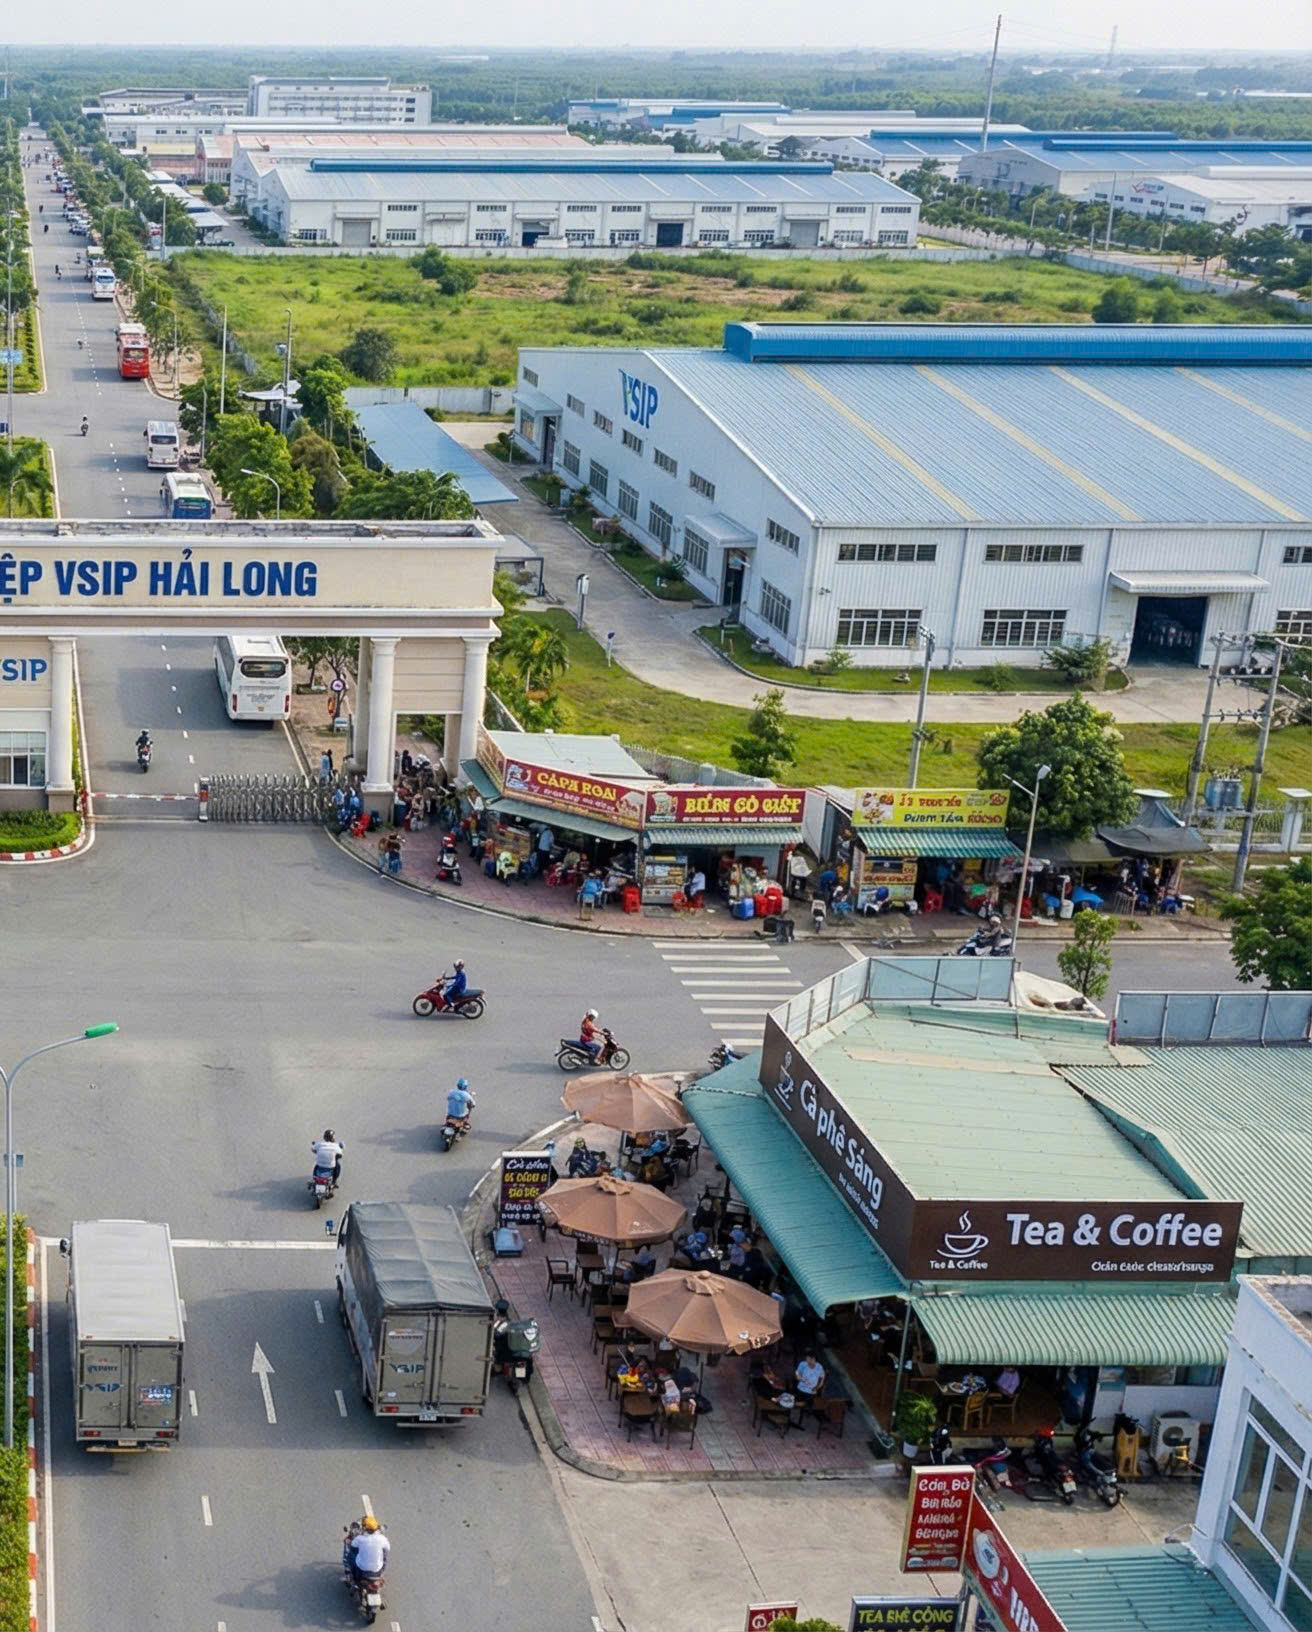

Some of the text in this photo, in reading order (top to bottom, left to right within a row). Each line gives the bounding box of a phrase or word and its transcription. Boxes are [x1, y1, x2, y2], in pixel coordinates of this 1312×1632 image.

[618, 368, 658, 429] VSIP
[55, 561, 137, 596] VSIP
[149, 549, 209, 596] HẢI
[224, 561, 317, 597] LONG
[817, 1108, 846, 1156] phê
[846, 1138, 883, 1209] Sáng
[1007, 1213, 1223, 1246] Tea & Coffee
[858, 1609, 884, 1624] TEA
